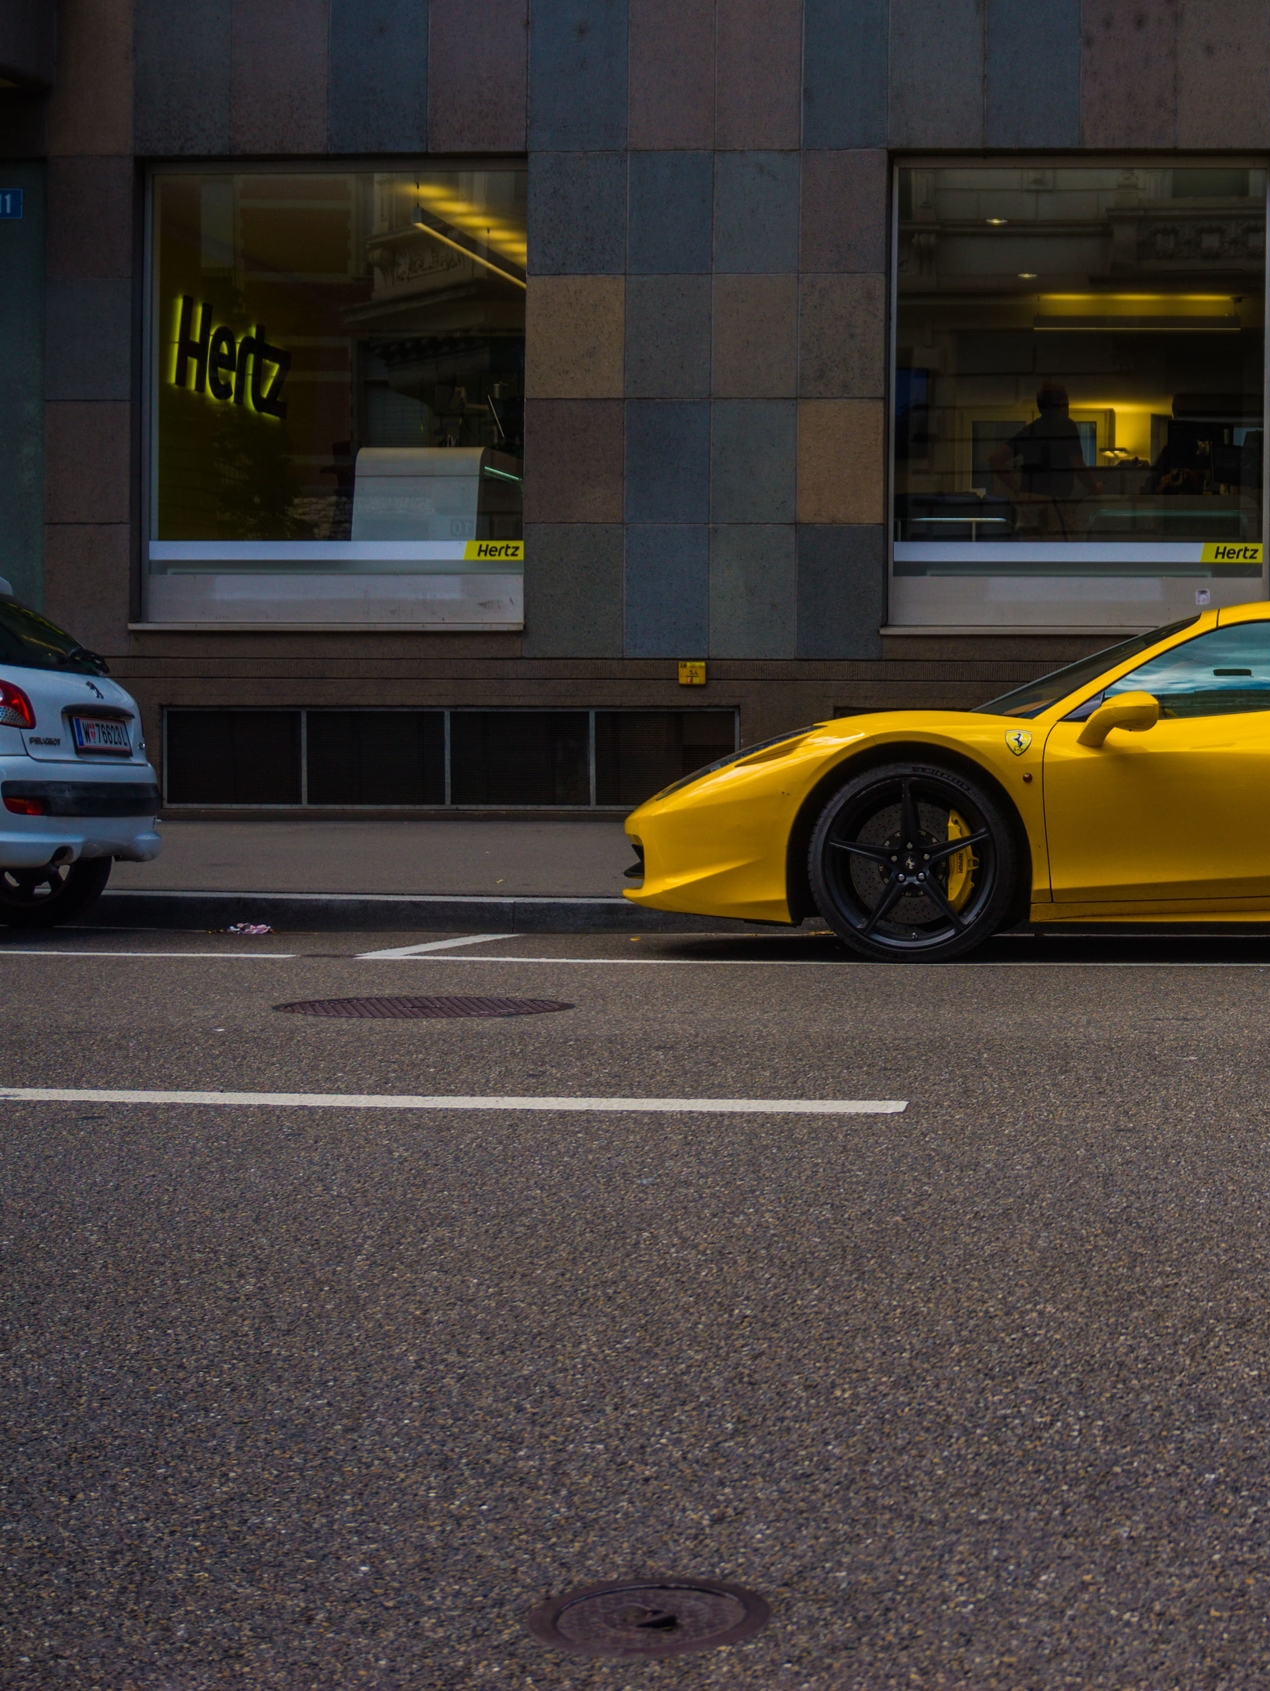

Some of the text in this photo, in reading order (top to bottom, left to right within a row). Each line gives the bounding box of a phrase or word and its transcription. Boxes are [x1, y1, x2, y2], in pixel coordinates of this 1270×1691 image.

[175, 294, 291, 419] Hertz
[476, 543, 520, 557] Hertz
[1213, 544, 1260, 560] Hertz
[95, 723, 128, 747] 76623L
